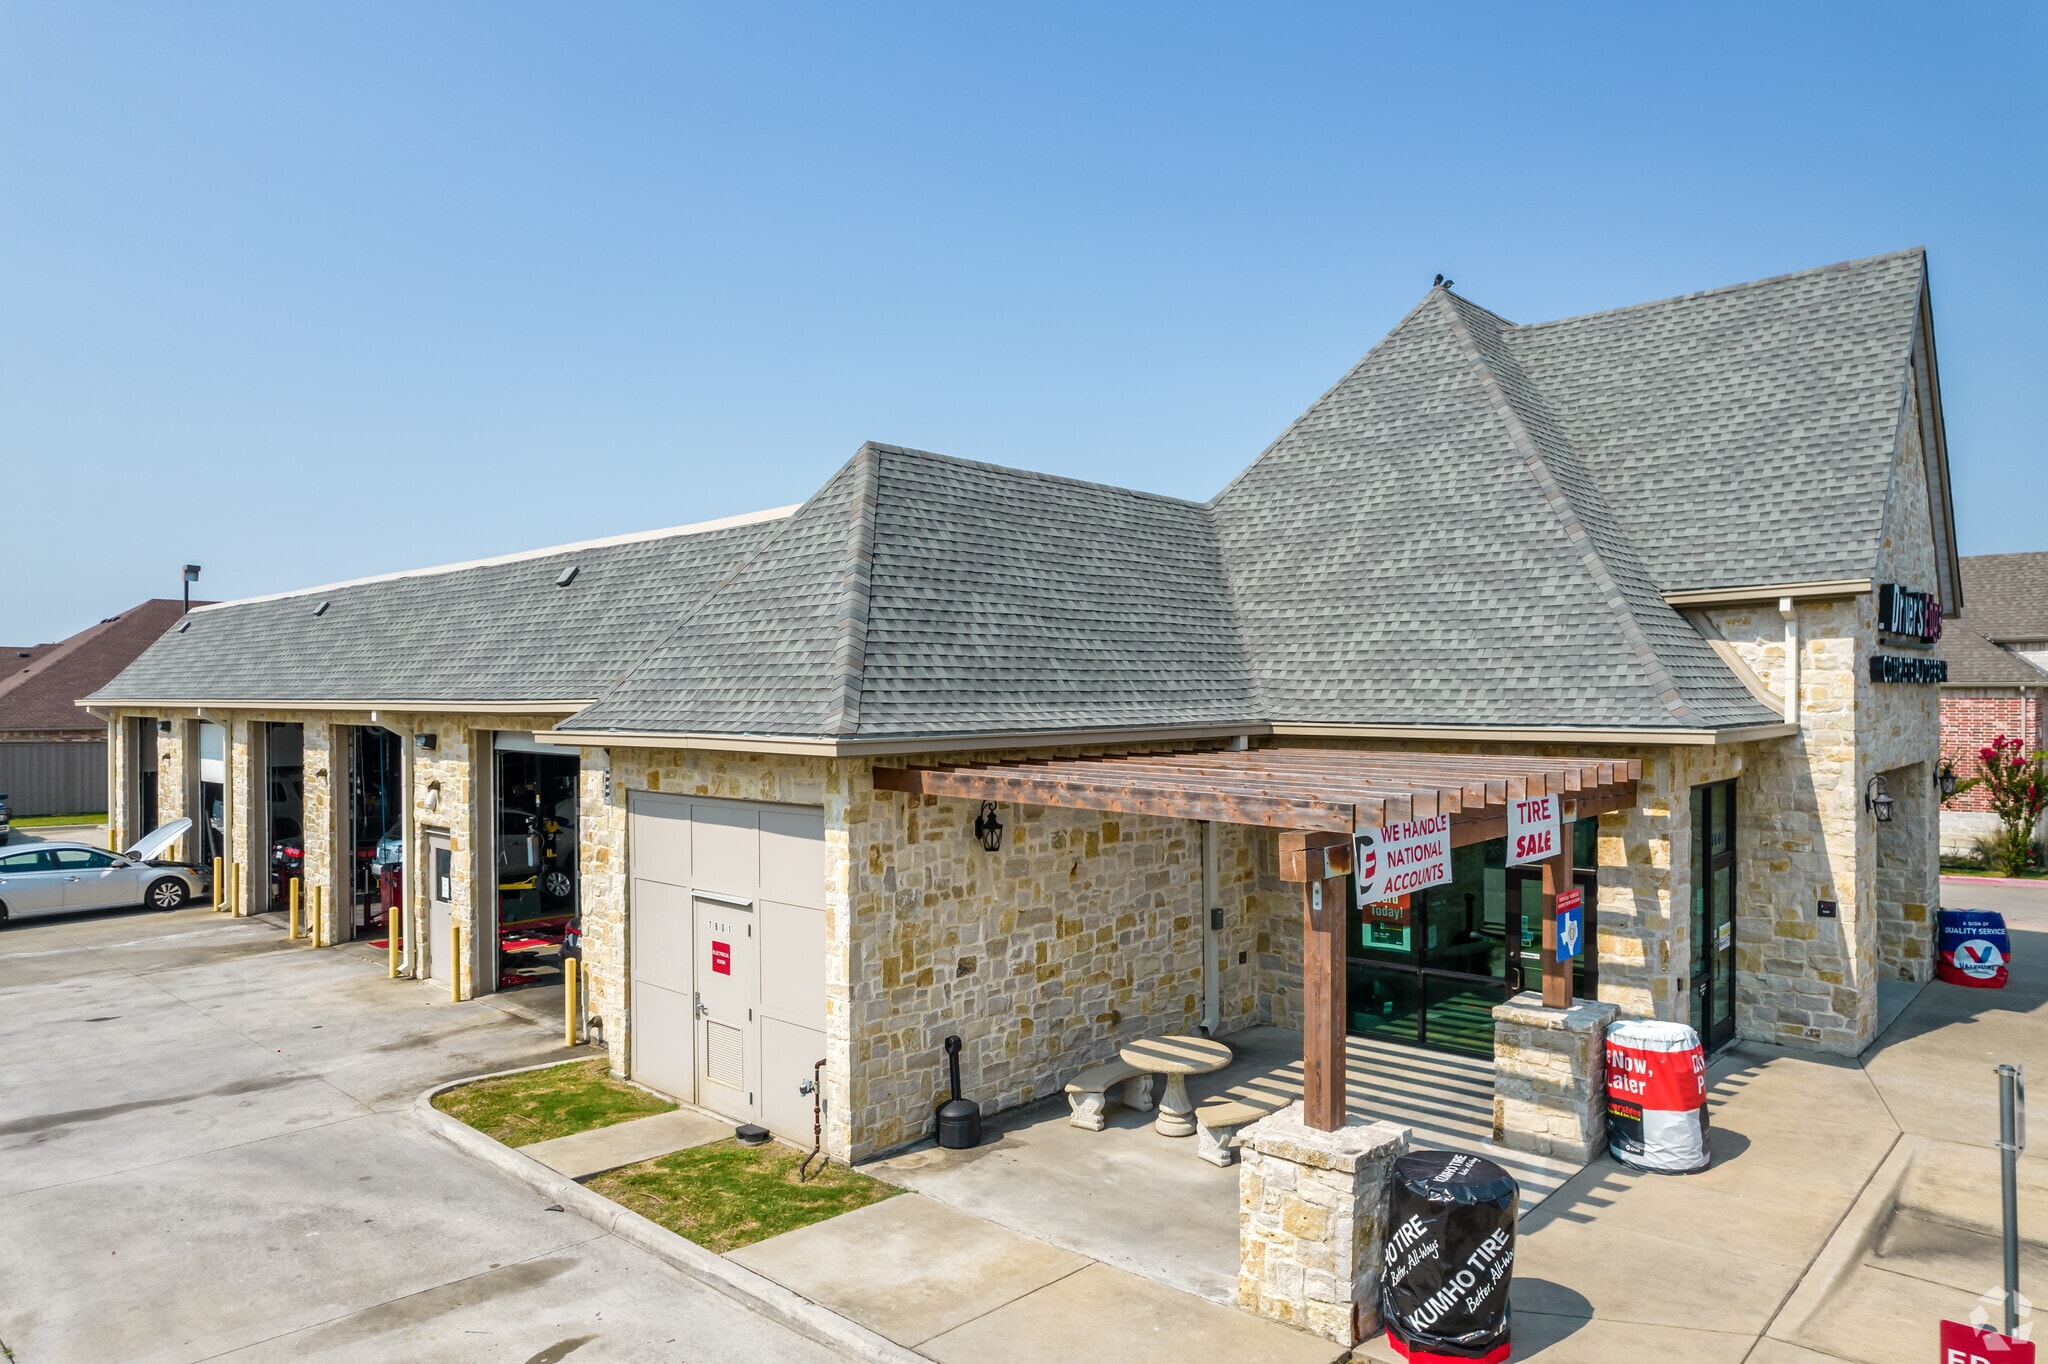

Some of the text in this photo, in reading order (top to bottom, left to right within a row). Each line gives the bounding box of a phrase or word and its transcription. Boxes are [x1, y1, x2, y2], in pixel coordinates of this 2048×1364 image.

[1516, 799, 1551, 824] TIRE
[1381, 815, 1446, 843] WE HANDLE
[1387, 840, 1443, 868] NATIONAL
[1516, 830, 1551, 858] SALE
[1383, 863, 1444, 894] ACCOUNTS
[1370, 904, 1404, 920] Today!
[1944, 927, 1977, 935] QUALITY
[1612, 1050, 1653, 1078] Now,
[1393, 1214, 1428, 1253] TIRE
[1408, 1269, 1476, 1332] KUMHO
[1467, 1227, 1509, 1271] TIRE
